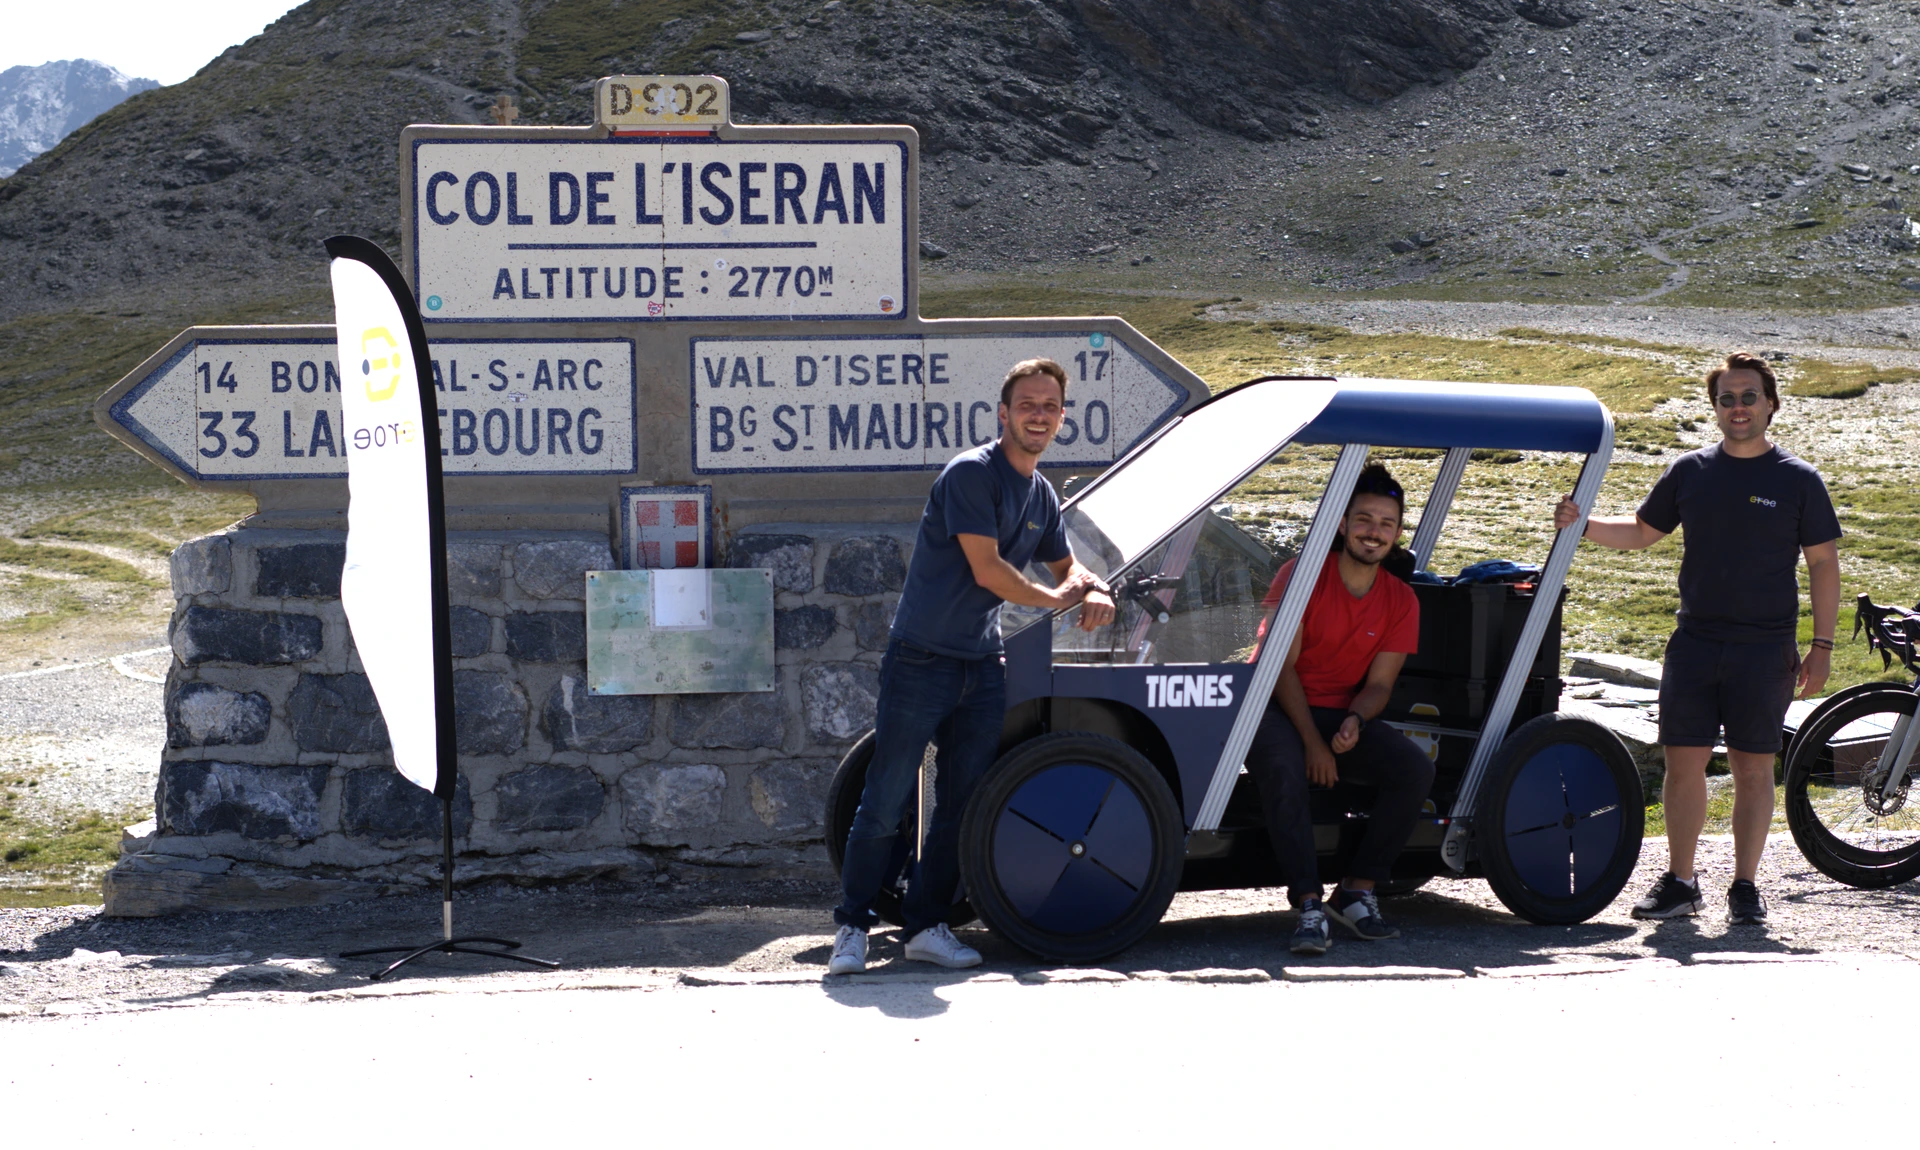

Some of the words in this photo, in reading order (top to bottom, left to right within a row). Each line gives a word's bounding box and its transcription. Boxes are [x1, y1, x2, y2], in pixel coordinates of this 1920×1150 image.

[610, 84, 632, 115] D
[426, 171, 533, 225] COL
[549, 171, 616, 225] DE
[635, 162, 886, 226] L'ISERAN
[493, 266, 684, 299] ALTITUDE
[197, 361, 238, 394] 14
[272, 359, 603, 394] BONAL-S-ARC
[704, 356, 775, 389] VAL
[796, 353, 949, 387] D'ISERE
[1075, 351, 1111, 381] 17
[199, 411, 260, 459] 33
[284, 407, 603, 458] LABOURG
[828, 401, 1002, 451] MAURIC
[1146, 674, 1234, 707] TIGNES
